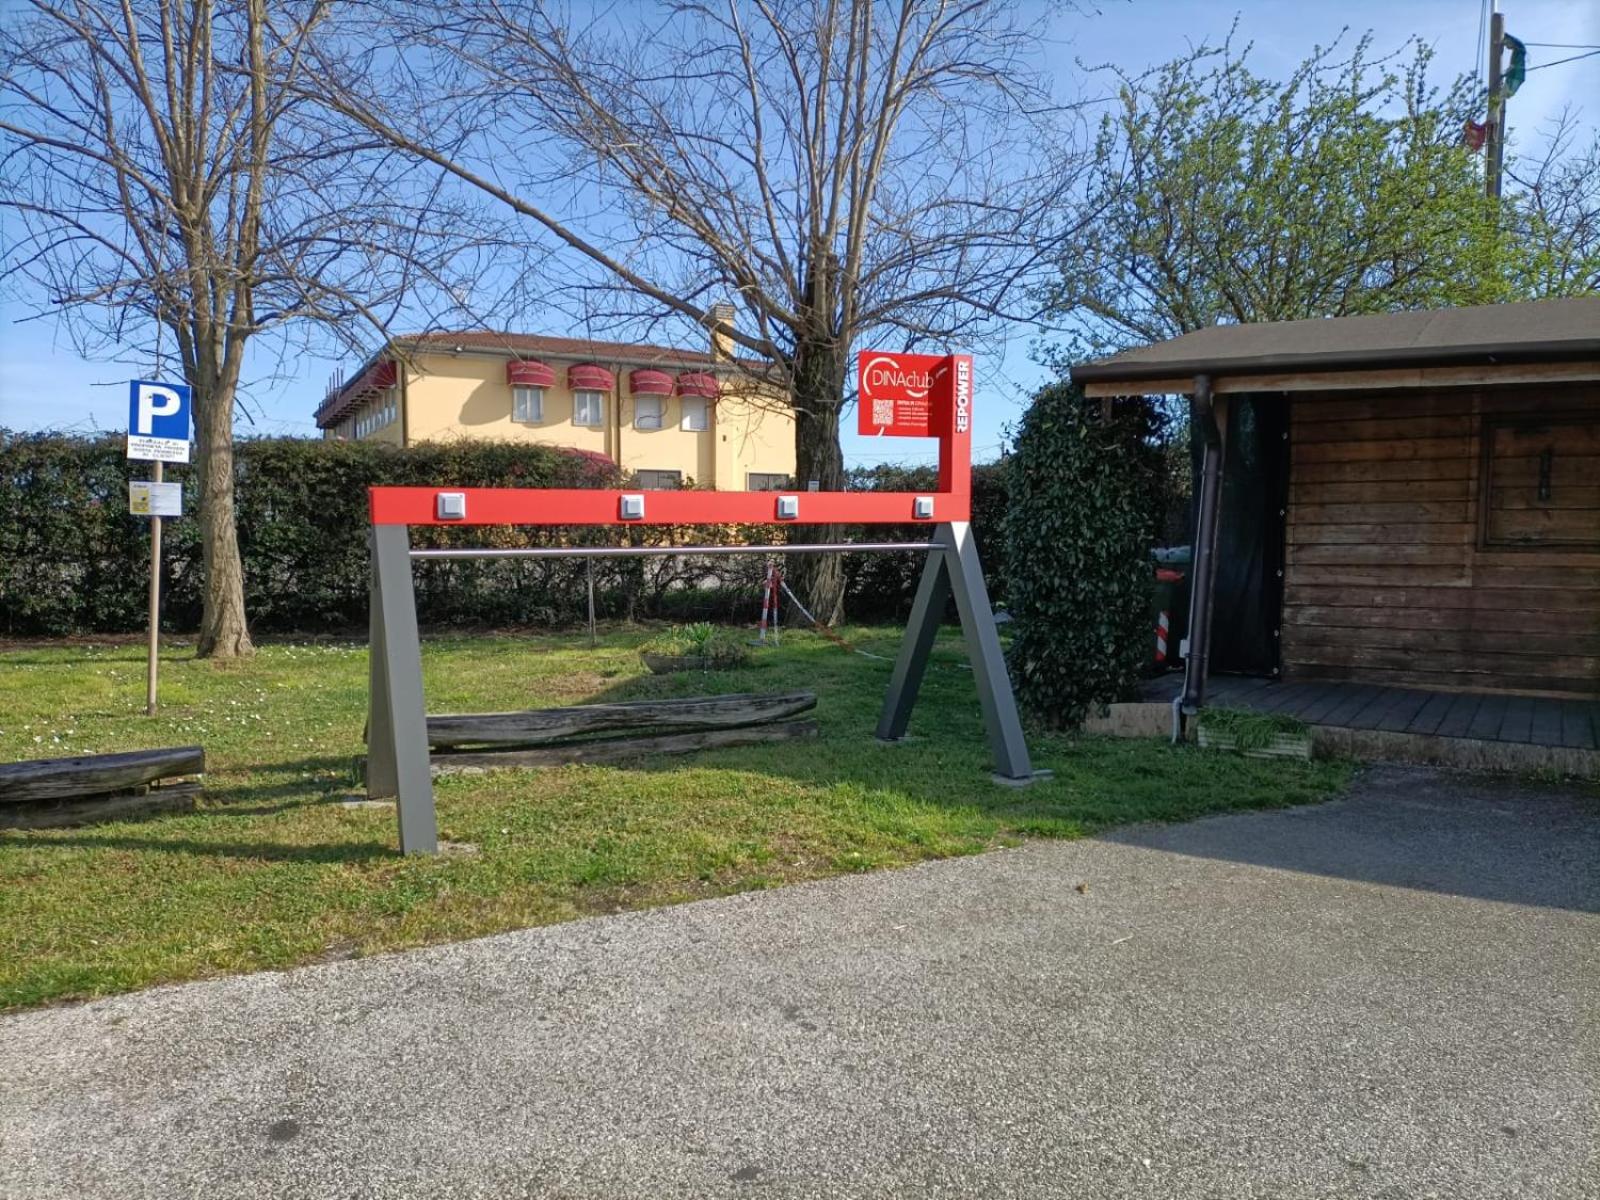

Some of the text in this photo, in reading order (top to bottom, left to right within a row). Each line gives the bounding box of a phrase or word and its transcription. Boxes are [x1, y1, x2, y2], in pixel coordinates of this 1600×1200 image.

[872, 369, 935, 389] DINAclub
[957, 361, 970, 433] REPOWER
[138, 384, 181, 434] P
